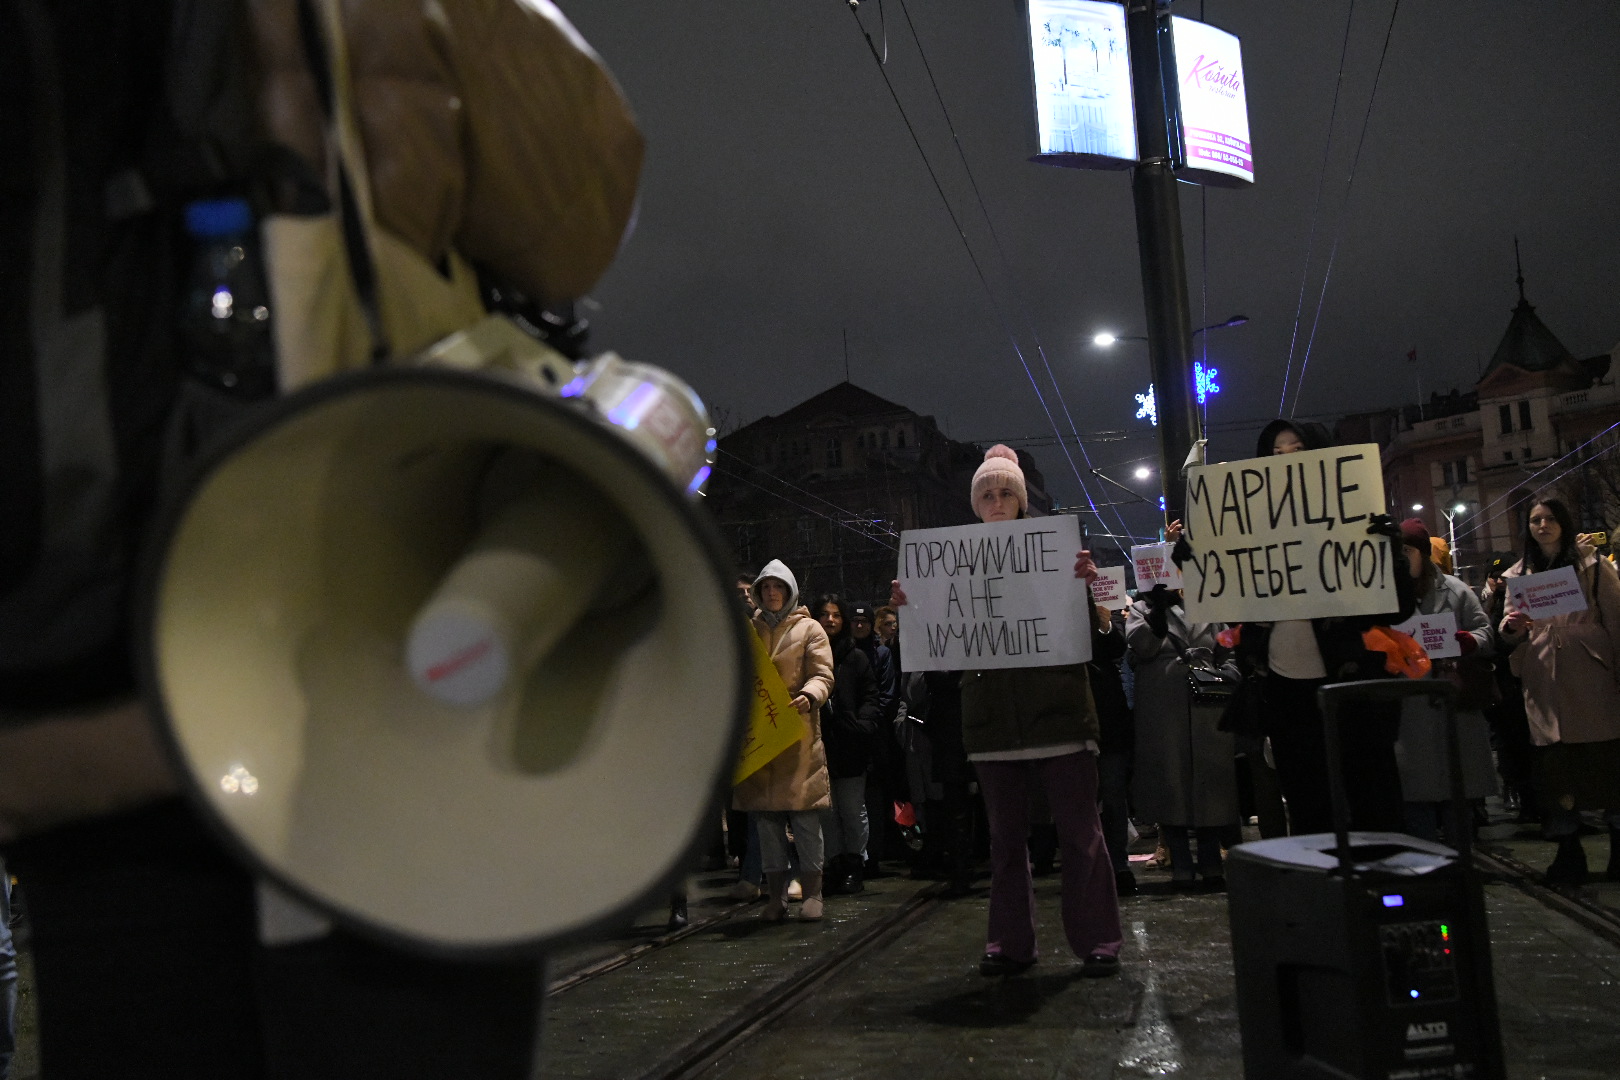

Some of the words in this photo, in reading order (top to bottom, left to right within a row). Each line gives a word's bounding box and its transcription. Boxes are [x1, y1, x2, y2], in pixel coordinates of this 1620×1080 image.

[1184, 54, 1240, 91] Košuta
[1191, 550, 1226, 603] УЗ
[1225, 541, 1307, 598] ТЕБЕ
[1319, 539, 1387, 593] СМО!
[947, 582, 964, 618] А
[969, 577, 1005, 618] НЕ
